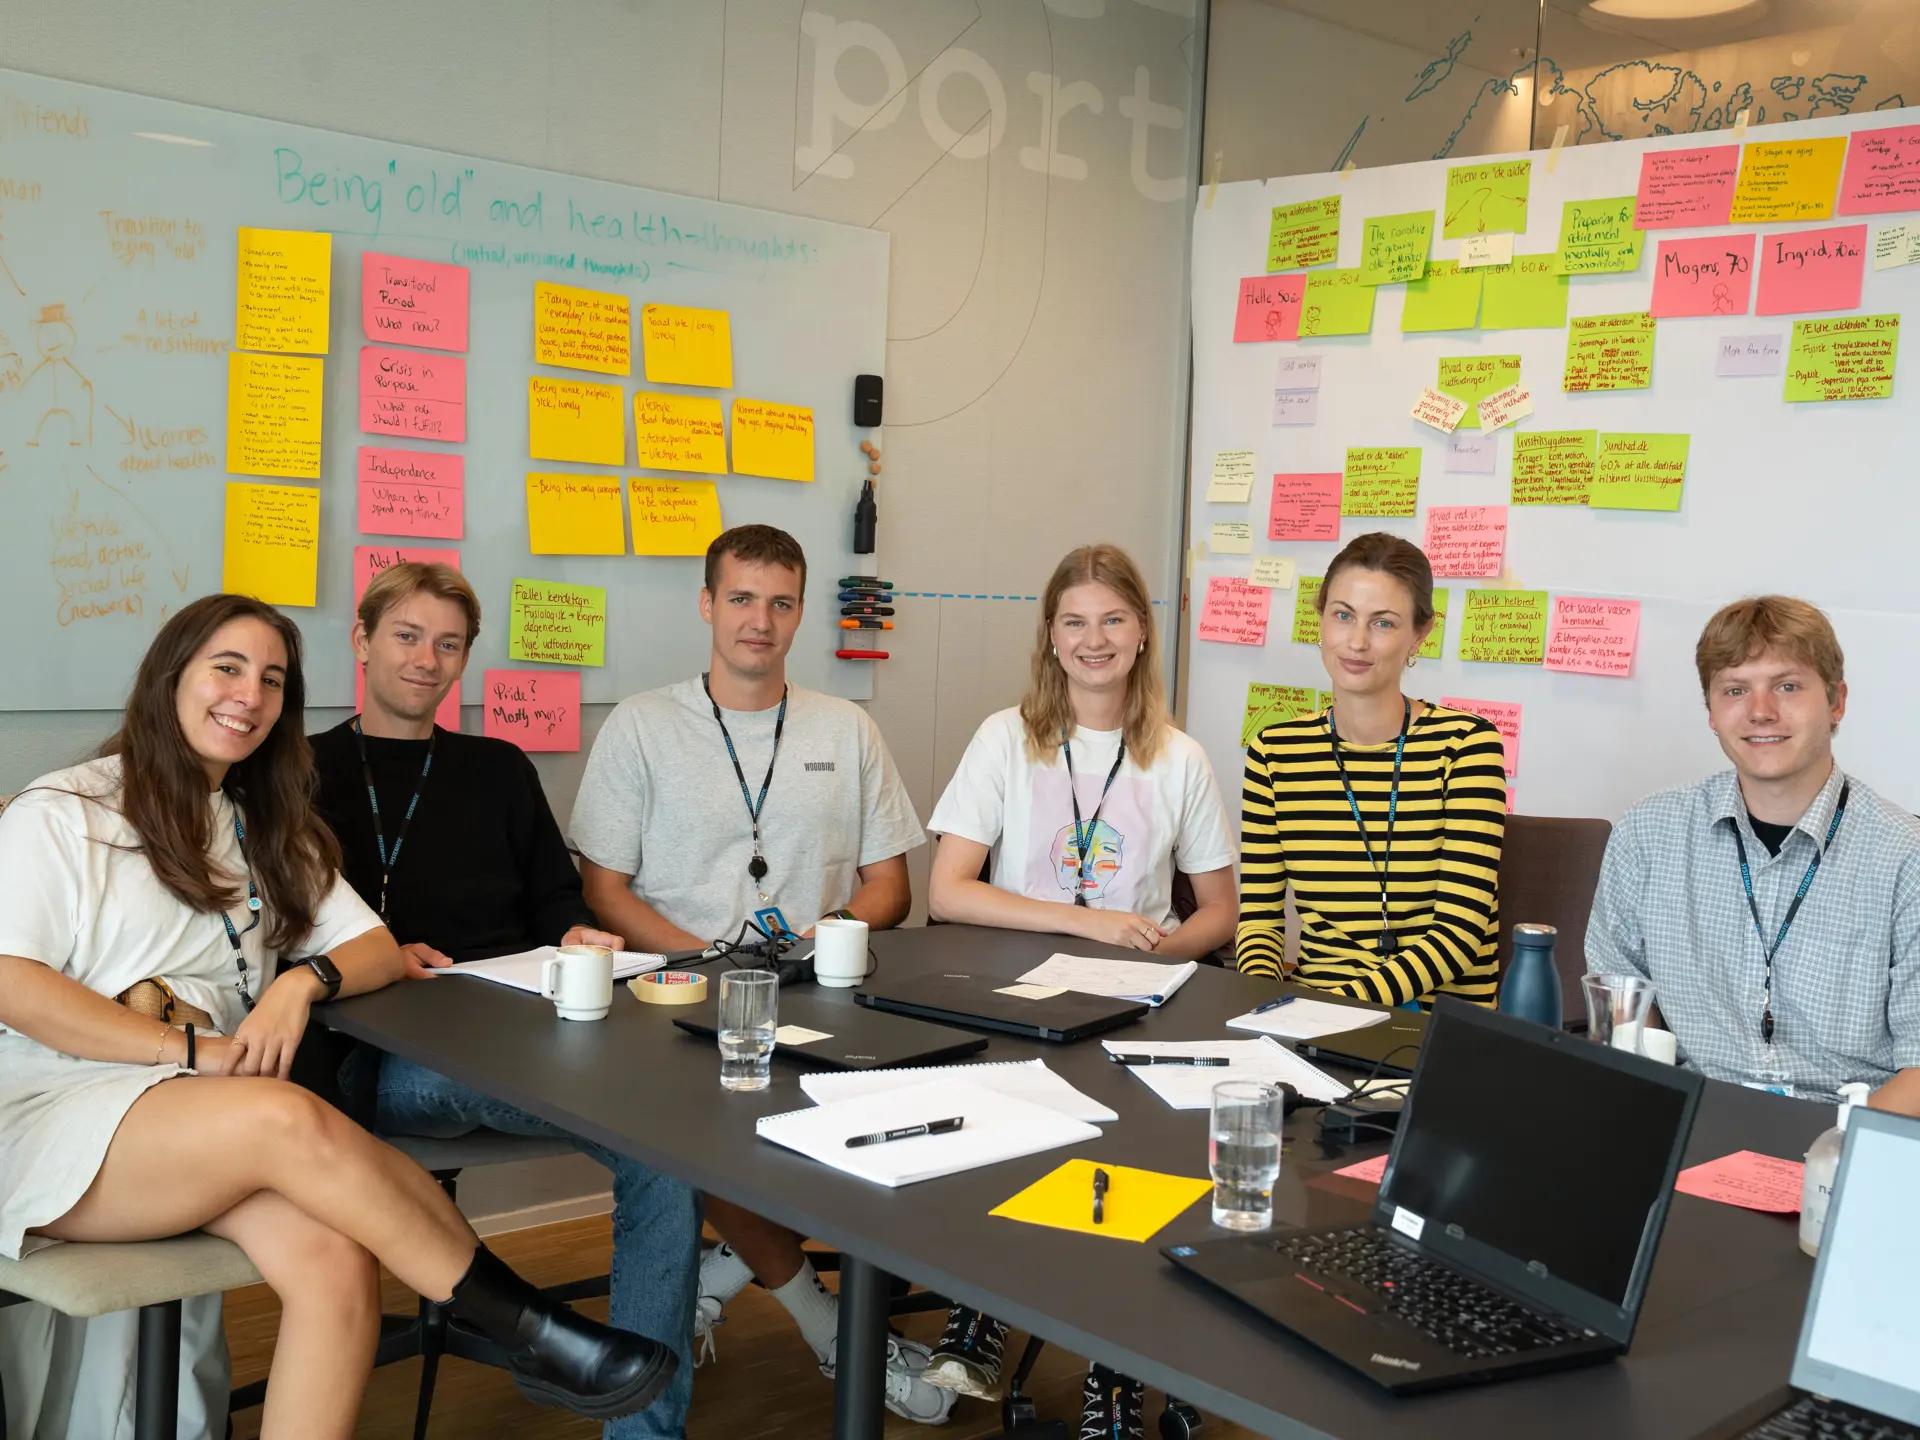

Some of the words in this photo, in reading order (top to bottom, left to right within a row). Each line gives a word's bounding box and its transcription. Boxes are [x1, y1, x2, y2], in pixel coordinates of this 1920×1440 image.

[274, 147, 383, 241] Being
[489, 190, 546, 233] and
[1572, 208, 1614, 232] Preparing
[1368, 224, 1385, 242] The
[1567, 228, 1620, 244] retirement
[1564, 247, 1611, 263] mentally
[1776, 239, 1832, 269] Ingrid,
[1664, 252, 1720, 284] Mogens,
[1726, 252, 1750, 276] 70
[378, 267, 437, 293] Transitional
[378, 289, 416, 308] Period
[1245, 284, 1275, 307] Helle,
[375, 315, 403, 330] What
[1722, 344, 1741, 358] More
[380, 357, 413, 377] Crisis
[422, 366, 435, 378] in
[1440, 360, 1462, 375] Hvad
[374, 374, 420, 393] Purpose
[532, 380, 557, 396] Being
[376, 400, 406, 412] What
[414, 404, 433, 415] role
[366, 454, 437, 480] Independence
[372, 488, 409, 503] Where
[413, 488, 428, 504] do
[540, 479, 561, 501] Being
[565, 481, 579, 494] the
[631, 482, 654, 501] Being
[656, 483, 679, 494] active
[371, 502, 395, 517] spend
[400, 508, 414, 525] my
[662, 513, 696, 531] healthy
[1558, 600, 1577, 614] Det
[804, 761, 836, 772] WOODBIRD
